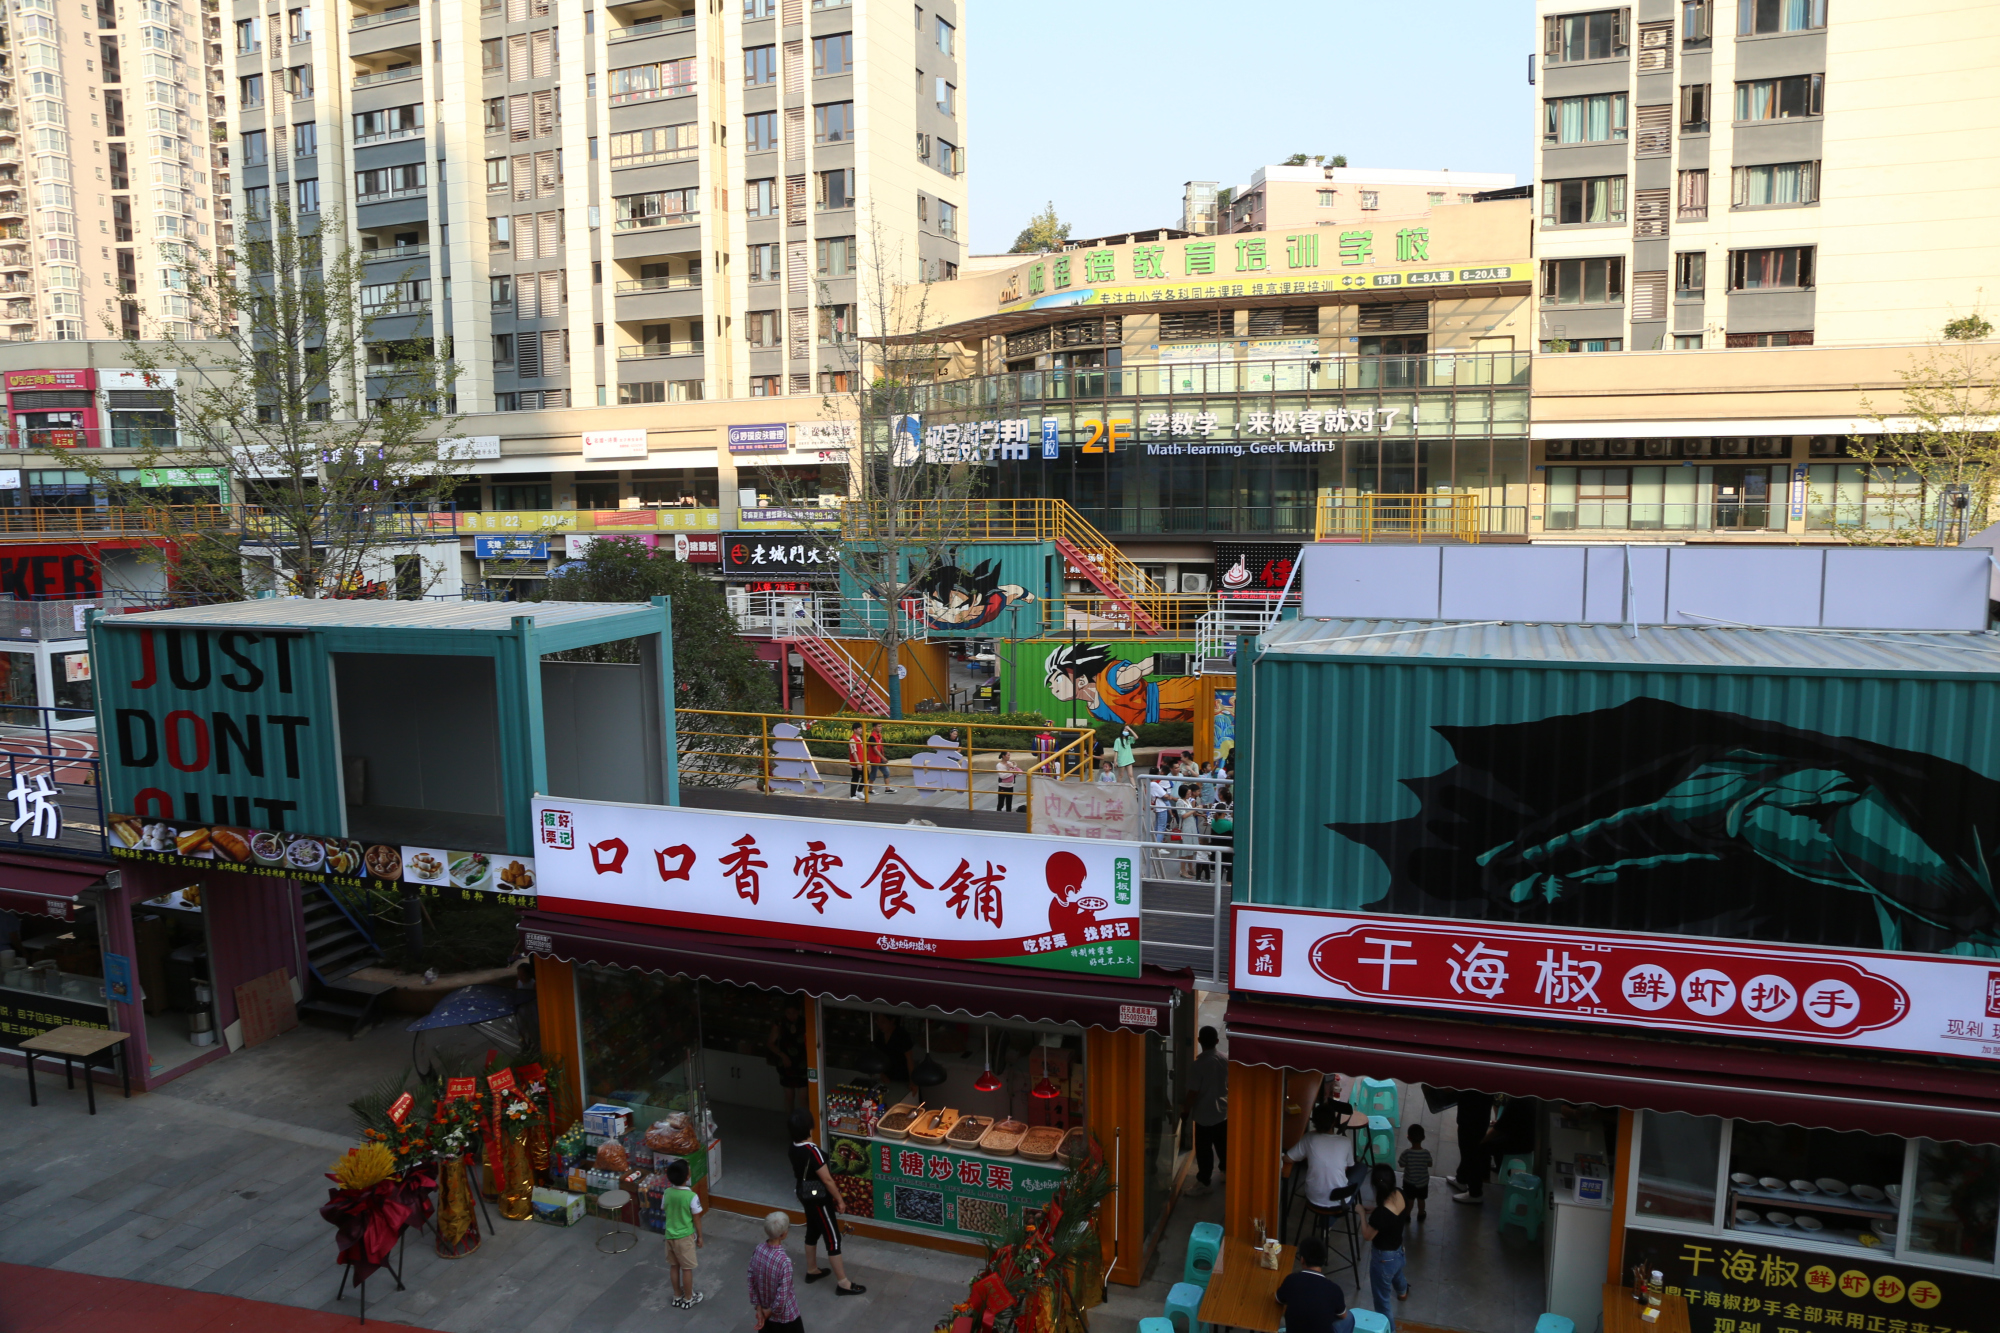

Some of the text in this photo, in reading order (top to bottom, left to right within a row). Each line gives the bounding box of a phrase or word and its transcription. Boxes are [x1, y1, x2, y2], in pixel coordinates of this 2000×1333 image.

[1028, 227, 1430, 293] 畅铭德教育培训学校
[1377, 274, 1398, 285] 1对1
[1044, 422, 1056, 456] 学校
[1082, 418, 1132, 453] 2F
[1147, 442, 1246, 457] Math-learning,
[1250, 441, 1285, 453] Geek
[131, 628, 305, 693] JUST
[115, 708, 309, 779] DONT
[7, 771, 60, 839] 坊
[146, 854, 177, 866] 小笼包
[588, 832, 1008, 929] 口口香零食铺
[1115, 858, 1130, 903] 好记板栗
[1022, 921, 1131, 955] 吃好栗 找好记
[1253, 932, 1276, 974] 云鼎
[1357, 935, 1855, 1022] 干海椒 鲜虾抄手
[1946, 1018, 1984, 1038] 现剁
[881, 1146, 891, 1172] 好记板栗
[898, 1149, 1014, 1192] 糖炒板栗
[883, 1192, 893, 1209] 瓜子
[945, 1203, 955, 1220] 花生
[1678, 1243, 1939, 1305] 干海椒 鲜虾抄手
